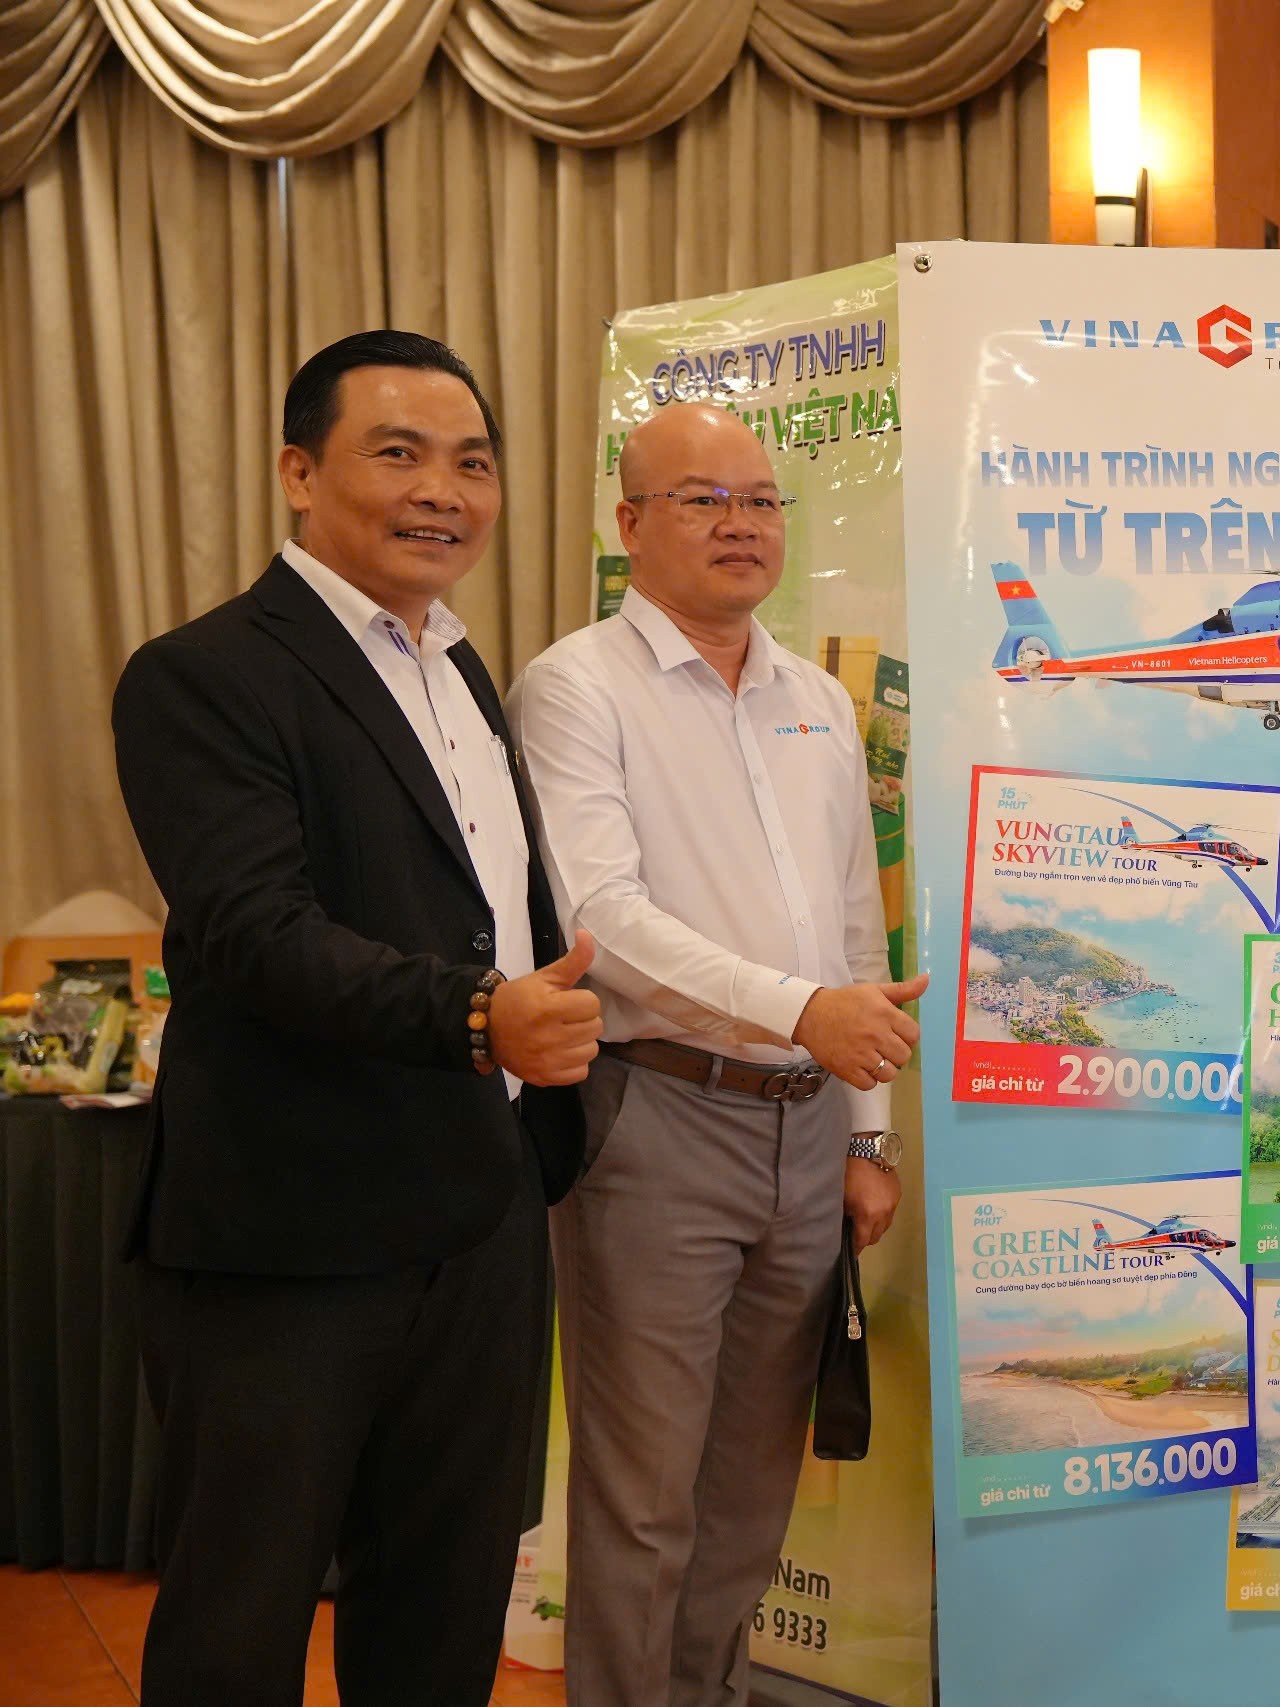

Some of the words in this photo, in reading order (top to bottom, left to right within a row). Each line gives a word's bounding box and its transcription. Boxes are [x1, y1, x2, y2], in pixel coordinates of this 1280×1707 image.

[653, 349, 739, 402] CÔNG
[745, 339, 784, 387] TY
[789, 319, 886, 380] TNHH
[775, 387, 847, 457] VIỆT
[981, 443, 1090, 488] HÀNH
[1101, 443, 1215, 488] TRÌNH
[1016, 498, 1108, 576] TỪ
[1188, 657, 1221, 666] Vietnam
[1221, 655, 1268, 667] Helicopters
[774, 723, 831, 735] VINAGROUP
[1001, 786, 1016, 799] 15
[995, 819, 1122, 846] VUNGTAU
[992, 842, 1109, 868] SKYVIEW
[1112, 856, 1158, 872] TOUR
[1023, 870, 1037, 879] bay
[1125, 877, 1141, 885] phố
[1162, 879, 1182, 888] Vũng
[971, 1074, 996, 1093] giá
[998, 1075, 1023, 1091] chỉ
[1025, 1077, 1045, 1092] từ
[975, 1204, 993, 1217] 40
[972, 1227, 1080, 1258] GREEN
[1257, 1235, 1279, 1254] giá
[972, 1252, 1116, 1280] COASTLINE
[1119, 1255, 1164, 1270] TOUR
[975, 1286, 997, 1294] Cung
[1025, 1283, 1040, 1291] bay
[1086, 1278, 1111, 1286] hoang
[1160, 1272, 1177, 1280] phía
[1177, 1271, 1198, 1279] Đông
[980, 1487, 1004, 1507] giá
[1006, 1483, 1030, 1501] chỉ
[1033, 1483, 1051, 1499] từ
[1063, 1437, 1237, 1496] 8.136.000
[774, 1557, 831, 1600] Nam
[1240, 1581, 1263, 1600] giá
[773, 1607, 828, 1650] 9333
